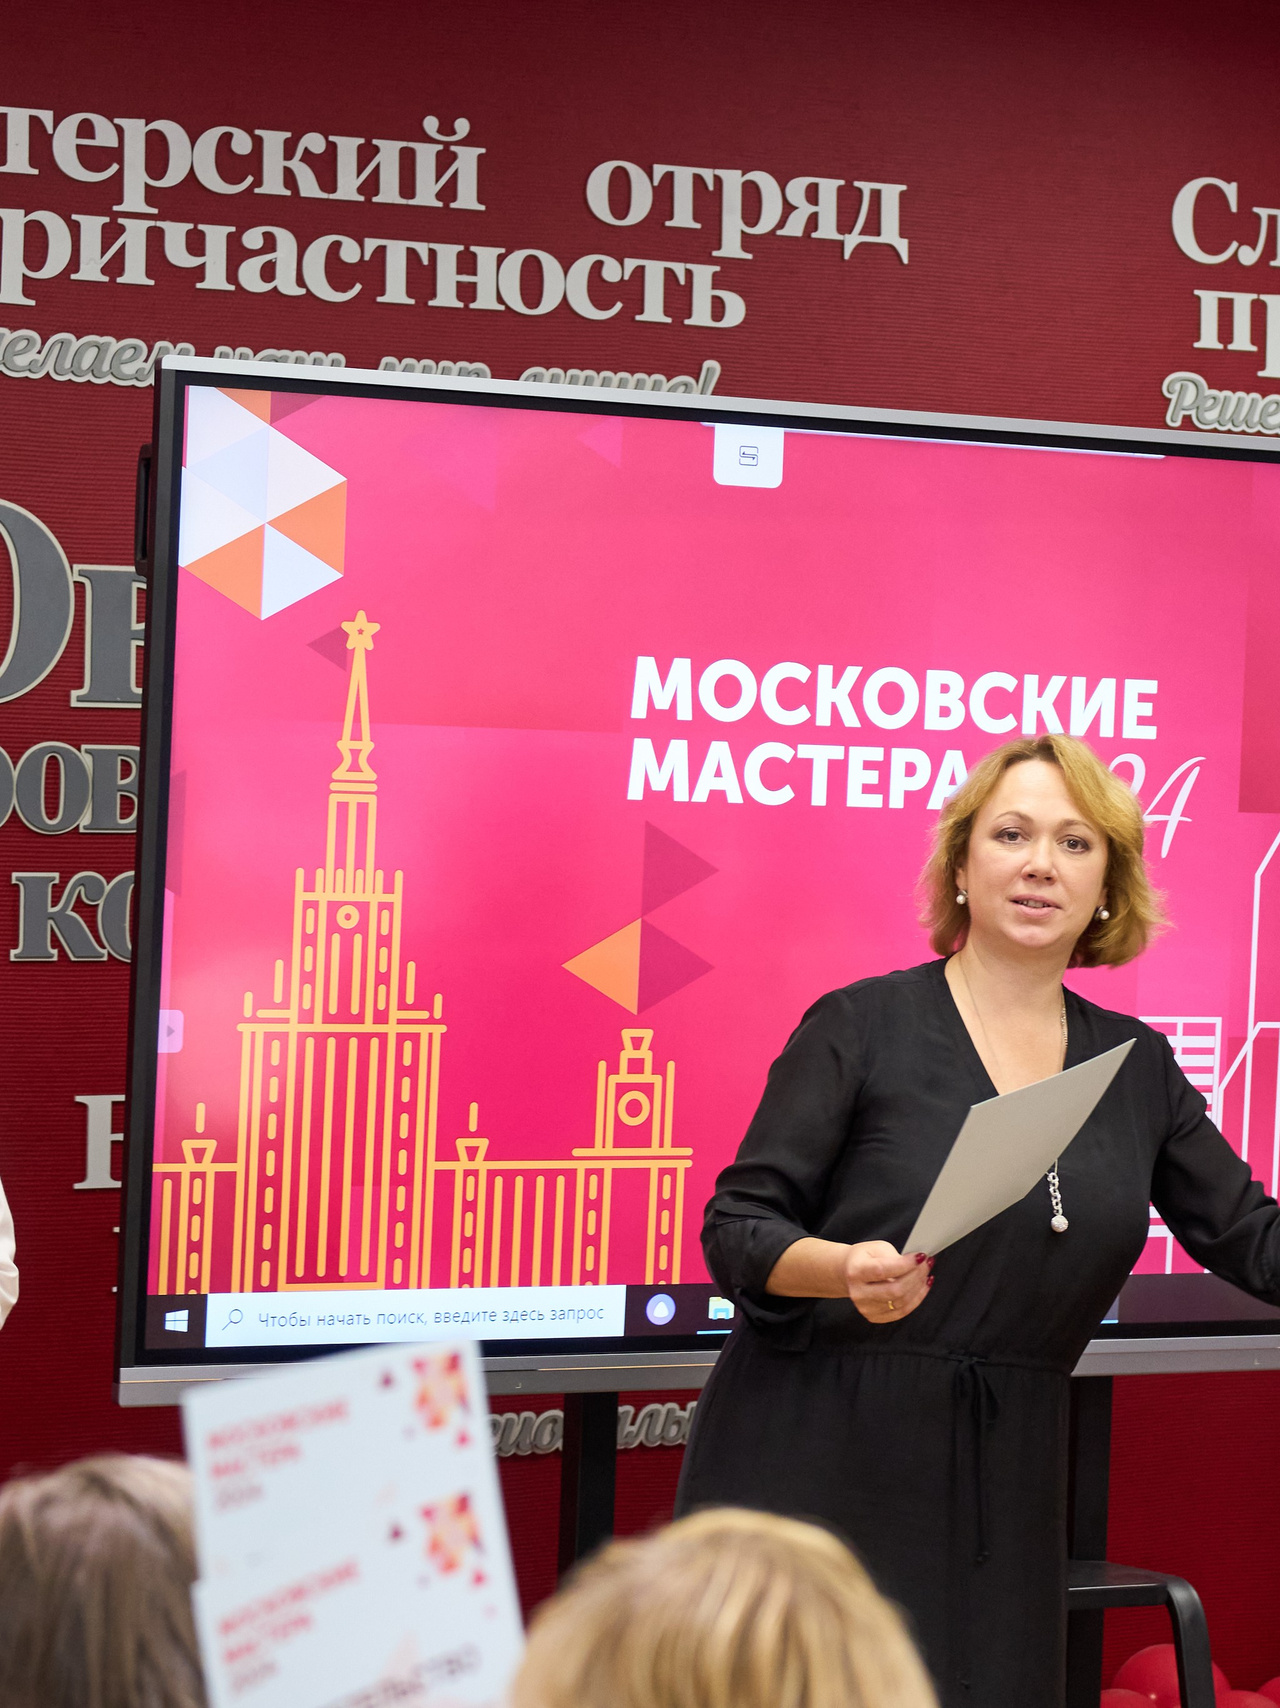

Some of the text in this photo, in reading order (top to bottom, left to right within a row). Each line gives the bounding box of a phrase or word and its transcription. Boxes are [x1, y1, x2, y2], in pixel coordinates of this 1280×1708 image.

[0, 106, 908, 264] терский отряд
[0, 208, 747, 328] ричастность
[630, 655, 1159, 740] МОСКОВСКИЕ
[626, 737, 969, 810] МАСТЕРА
[258, 1306, 604, 1328] Чтобы начать поиск, введите здесь запрос
